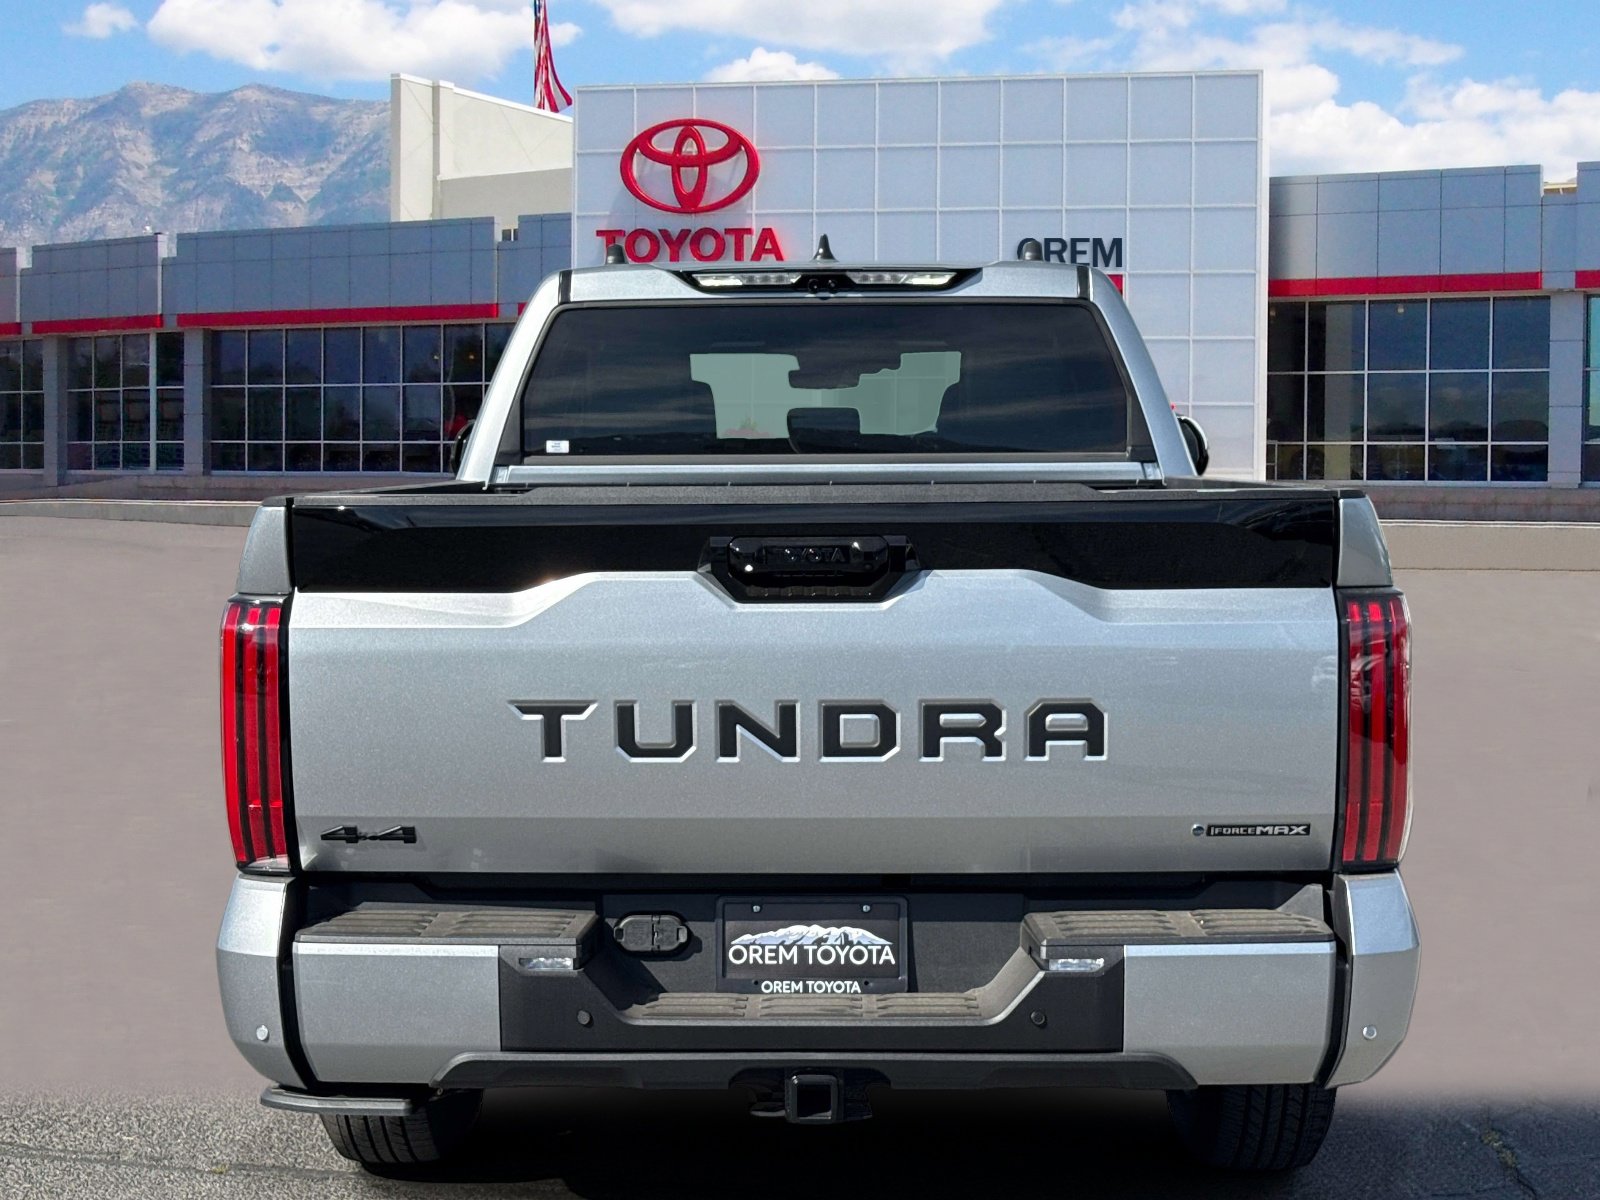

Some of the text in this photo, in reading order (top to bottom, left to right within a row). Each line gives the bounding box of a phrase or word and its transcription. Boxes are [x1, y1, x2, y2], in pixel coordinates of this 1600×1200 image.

[596, 227, 784, 263] TOYOTA
[508, 698, 1107, 762] TUNDRA
[728, 945, 896, 965] OREM TOYOTA
[760, 980, 862, 994] OREM TOYOTA
